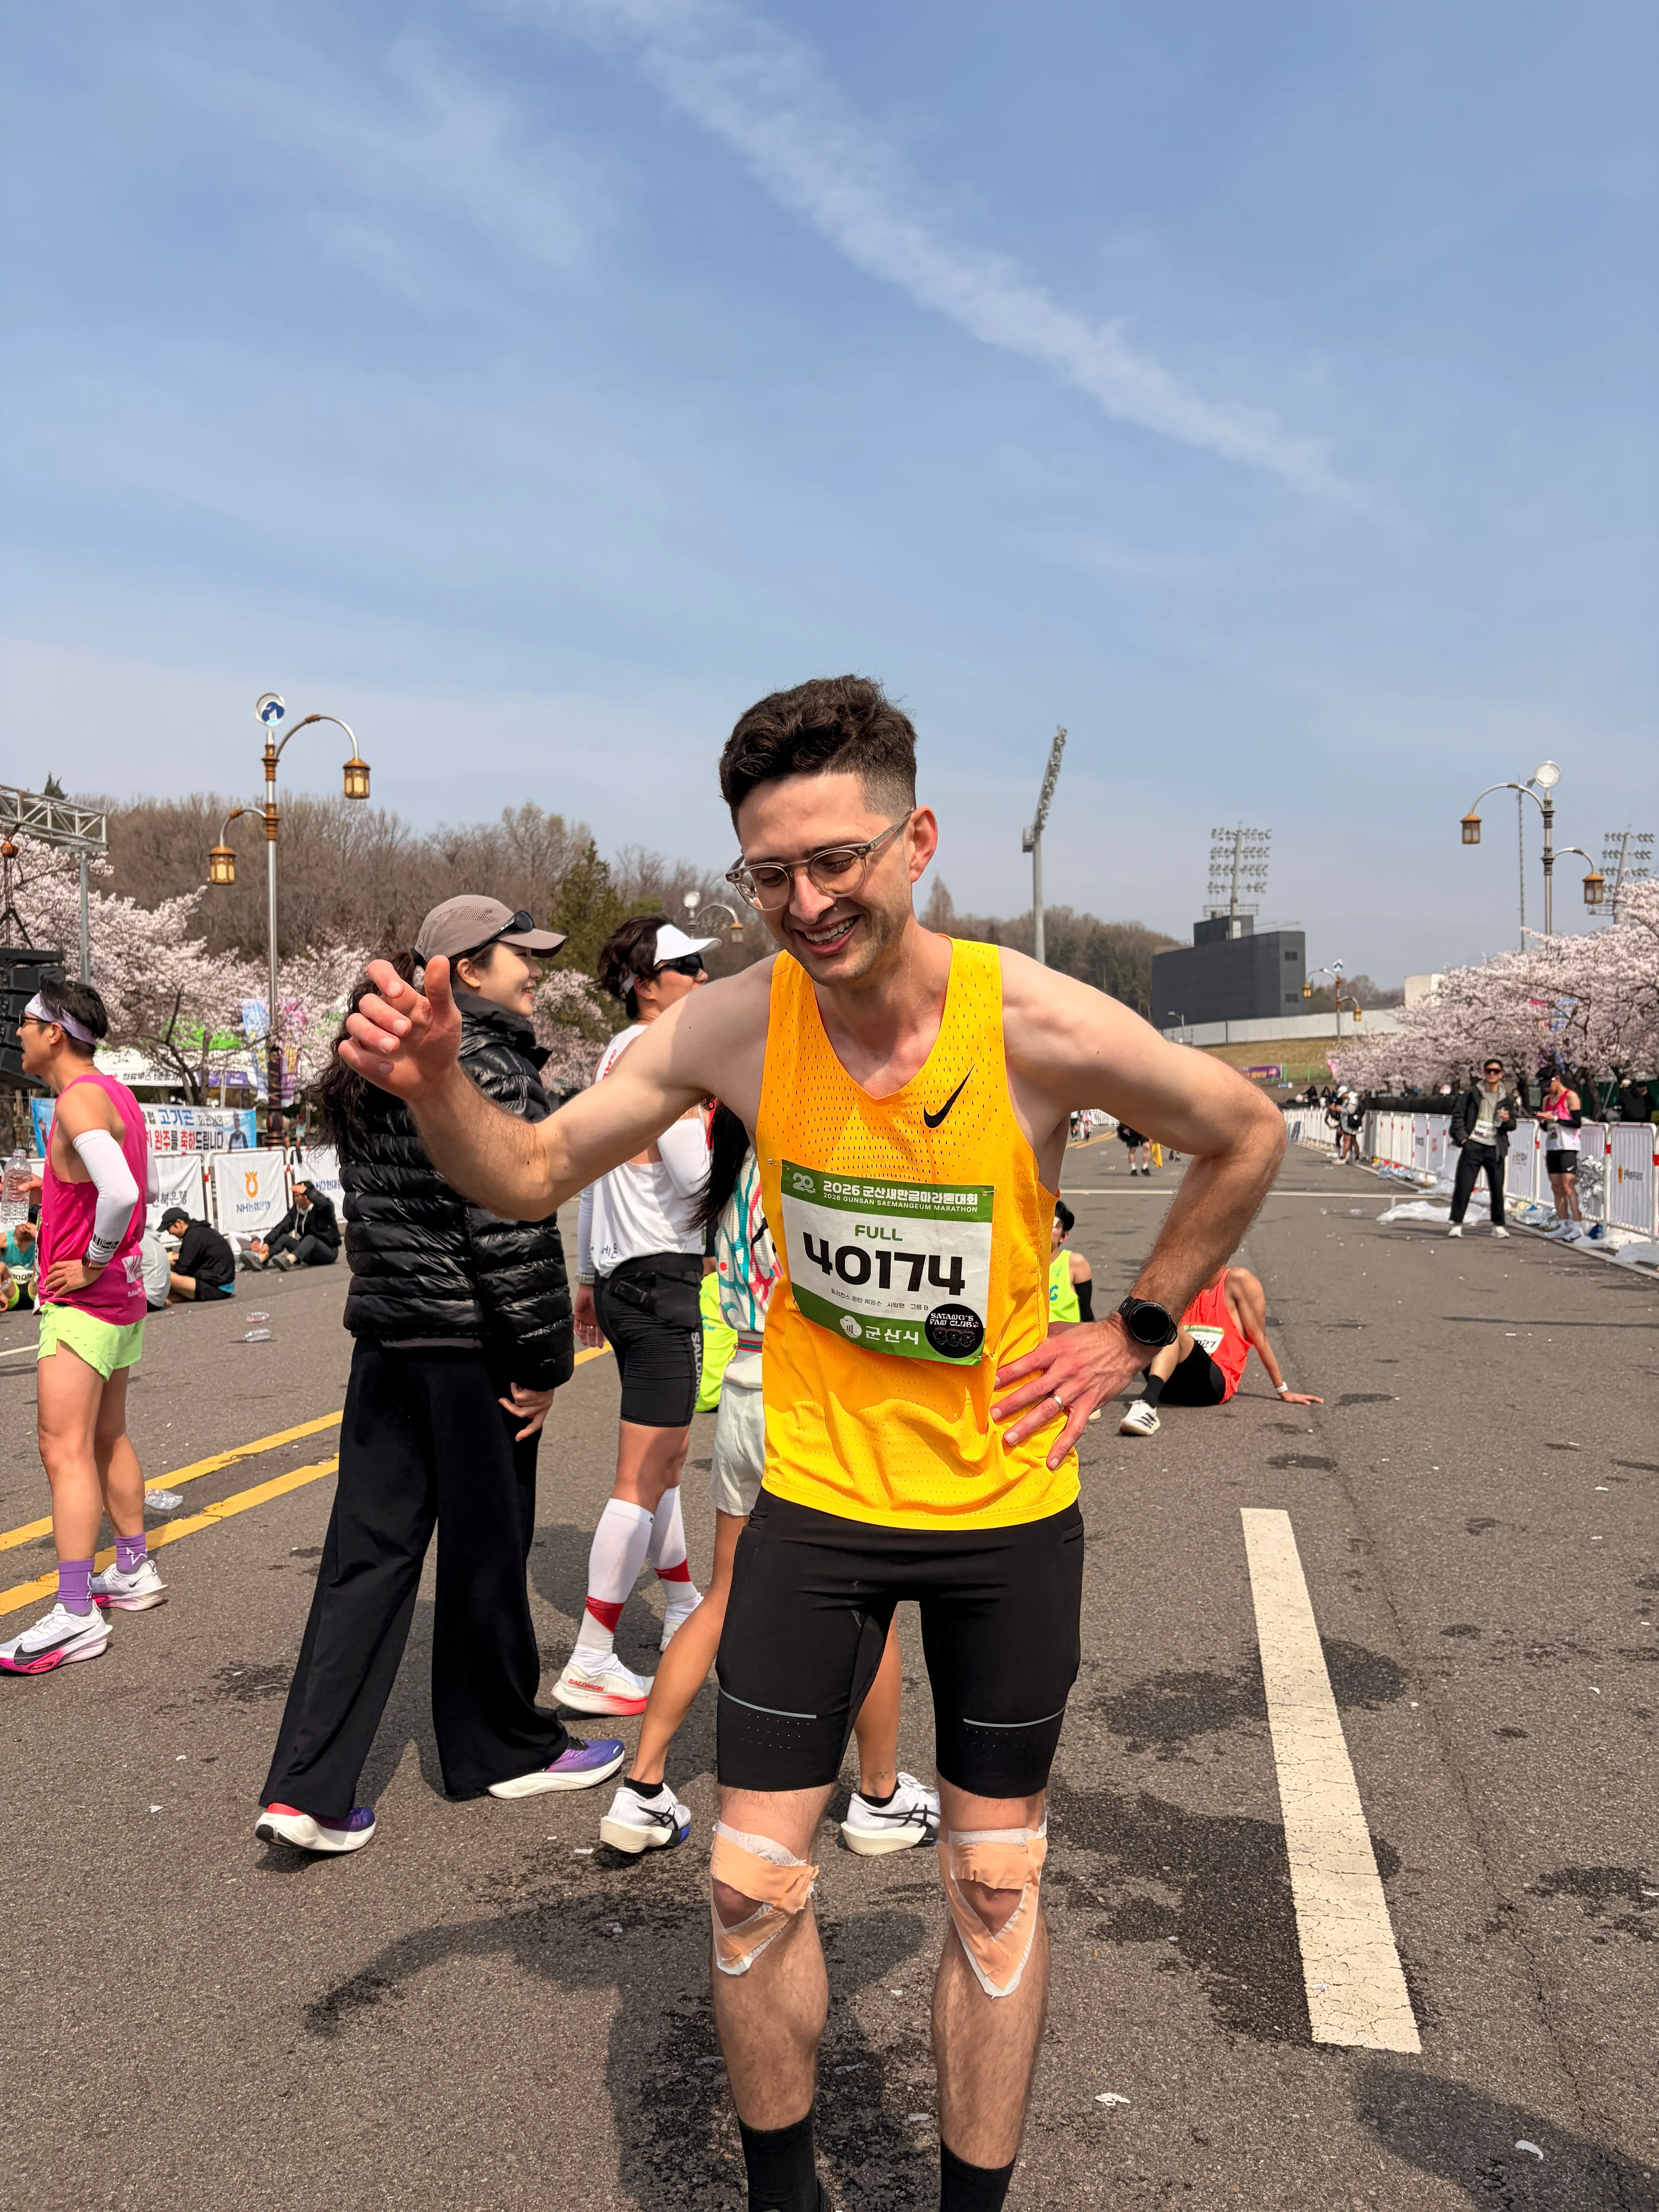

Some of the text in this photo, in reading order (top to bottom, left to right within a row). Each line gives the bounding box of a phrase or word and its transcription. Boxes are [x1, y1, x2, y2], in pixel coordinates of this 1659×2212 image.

[158, 1109, 194, 1126] 고기곤
[155, 1130, 178, 1151] 완주를
[181, 1130, 223, 1150] 축하드립니다
[823, 1180, 978, 1205] 2026 군산새만금마라톤대회
[823, 1192, 841, 1200] 2026
[843, 1196, 874, 1205] GUNSAN
[877, 1200, 931, 1210] SAEMANGEUM
[855, 1224, 903, 1242] FULL
[803, 1231, 965, 1296] 40174
[931, 1313, 974, 1321] SATANG'S
[865, 1326, 919, 1345] 군산시
[568, 1678, 604, 1692] SALOMON
